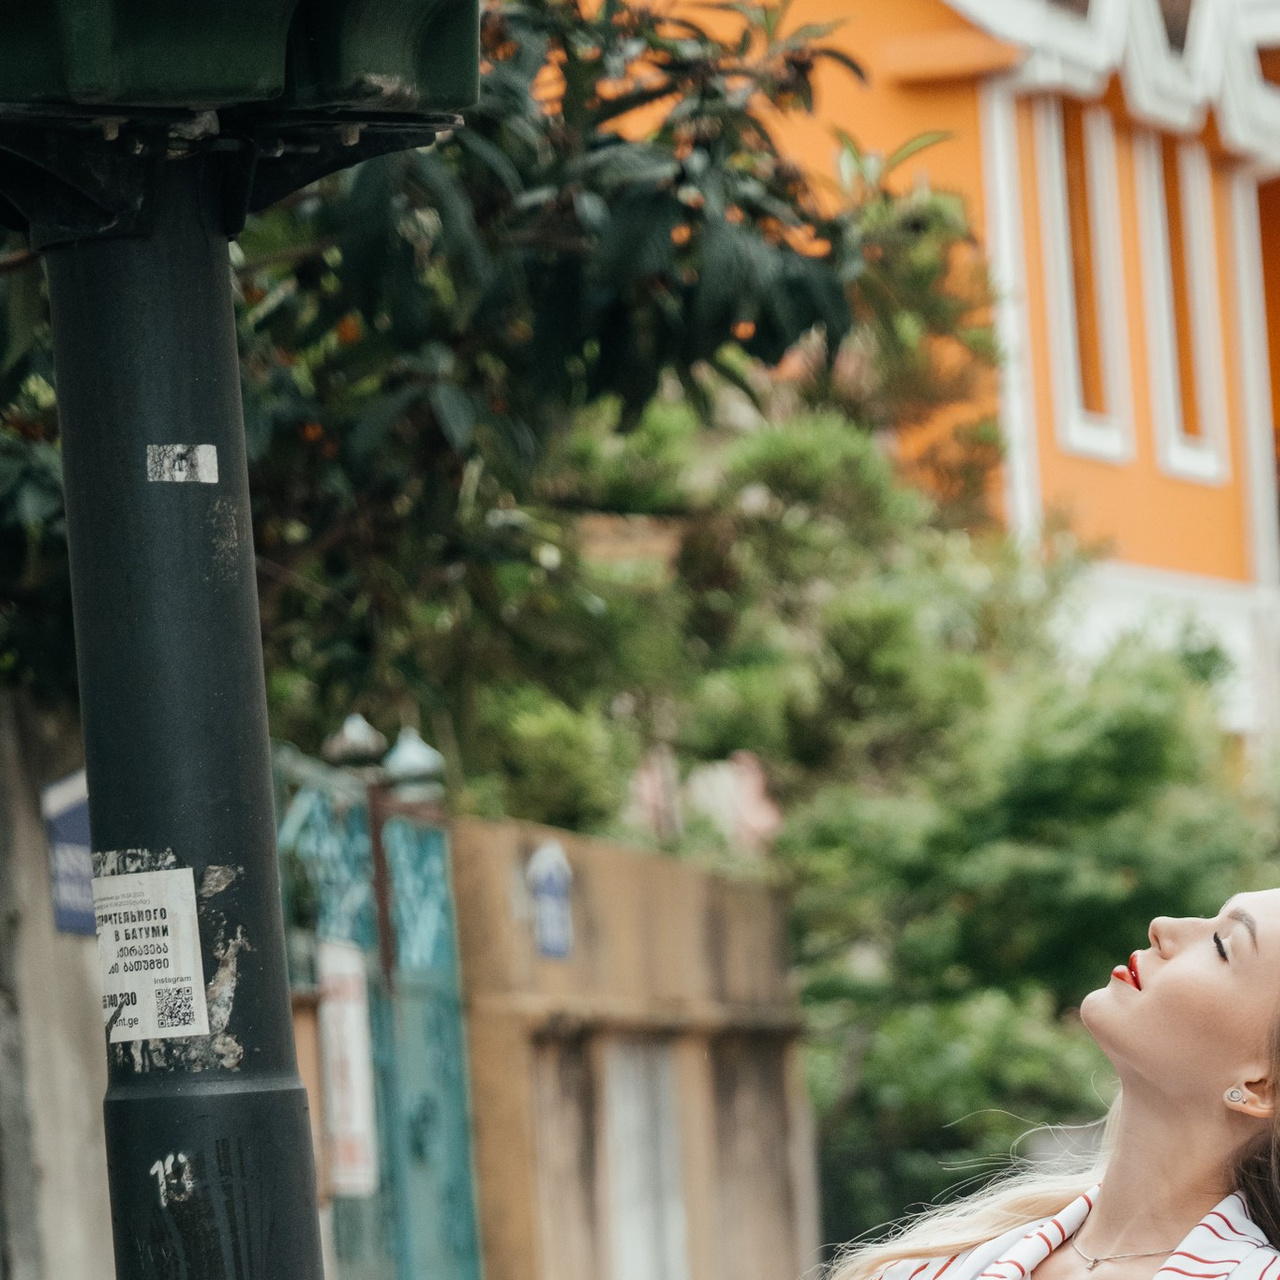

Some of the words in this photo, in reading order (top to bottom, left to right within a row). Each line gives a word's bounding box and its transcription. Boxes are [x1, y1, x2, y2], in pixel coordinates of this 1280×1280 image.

[114, 929, 120, 942] В
[124, 925, 169, 941] БАТУМИ
[123, 958, 170, 973] ბათუმში
[154, 976, 192, 985] Instagram
